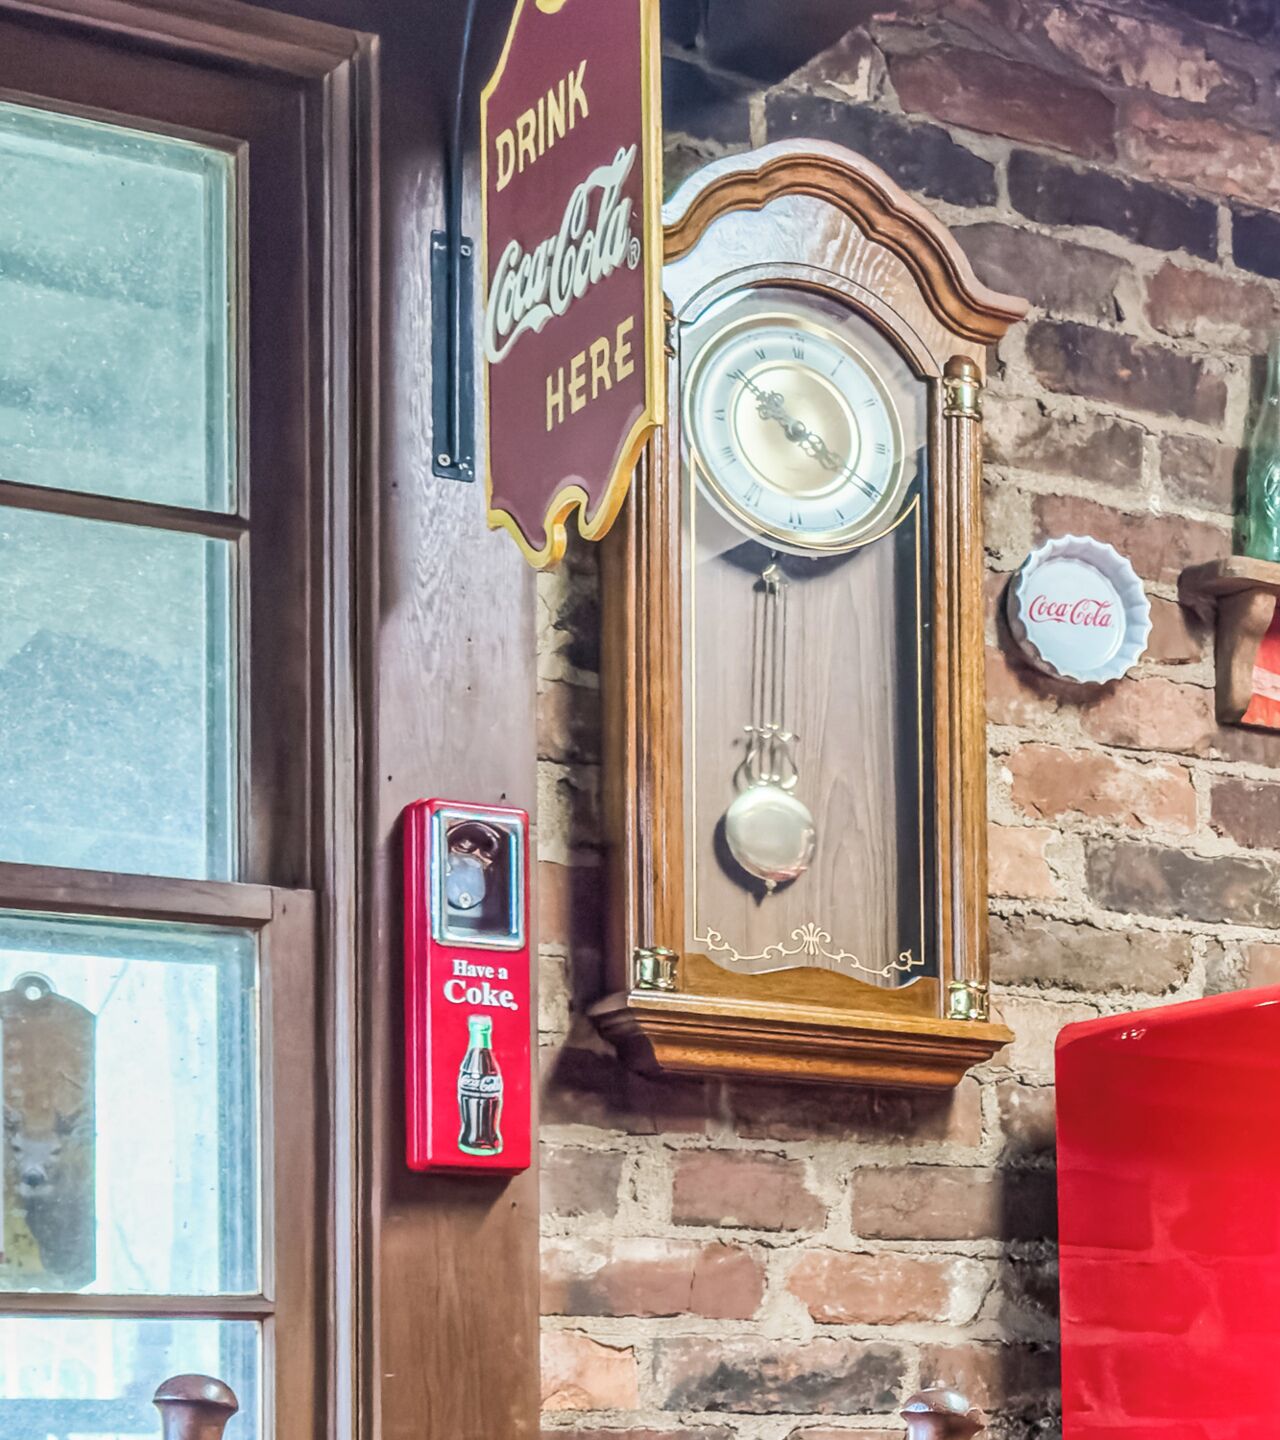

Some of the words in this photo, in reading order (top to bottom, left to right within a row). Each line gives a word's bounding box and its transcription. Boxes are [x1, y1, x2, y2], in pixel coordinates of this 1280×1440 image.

[495, 59, 589, 192] DRINK
[484, 143, 637, 364] Coca-Cola
[545, 316, 635, 431] HERE
[1028, 594, 1114, 628] Coca-Cola
[452, 958, 495, 979] Have
[497, 966, 509, 980] a
